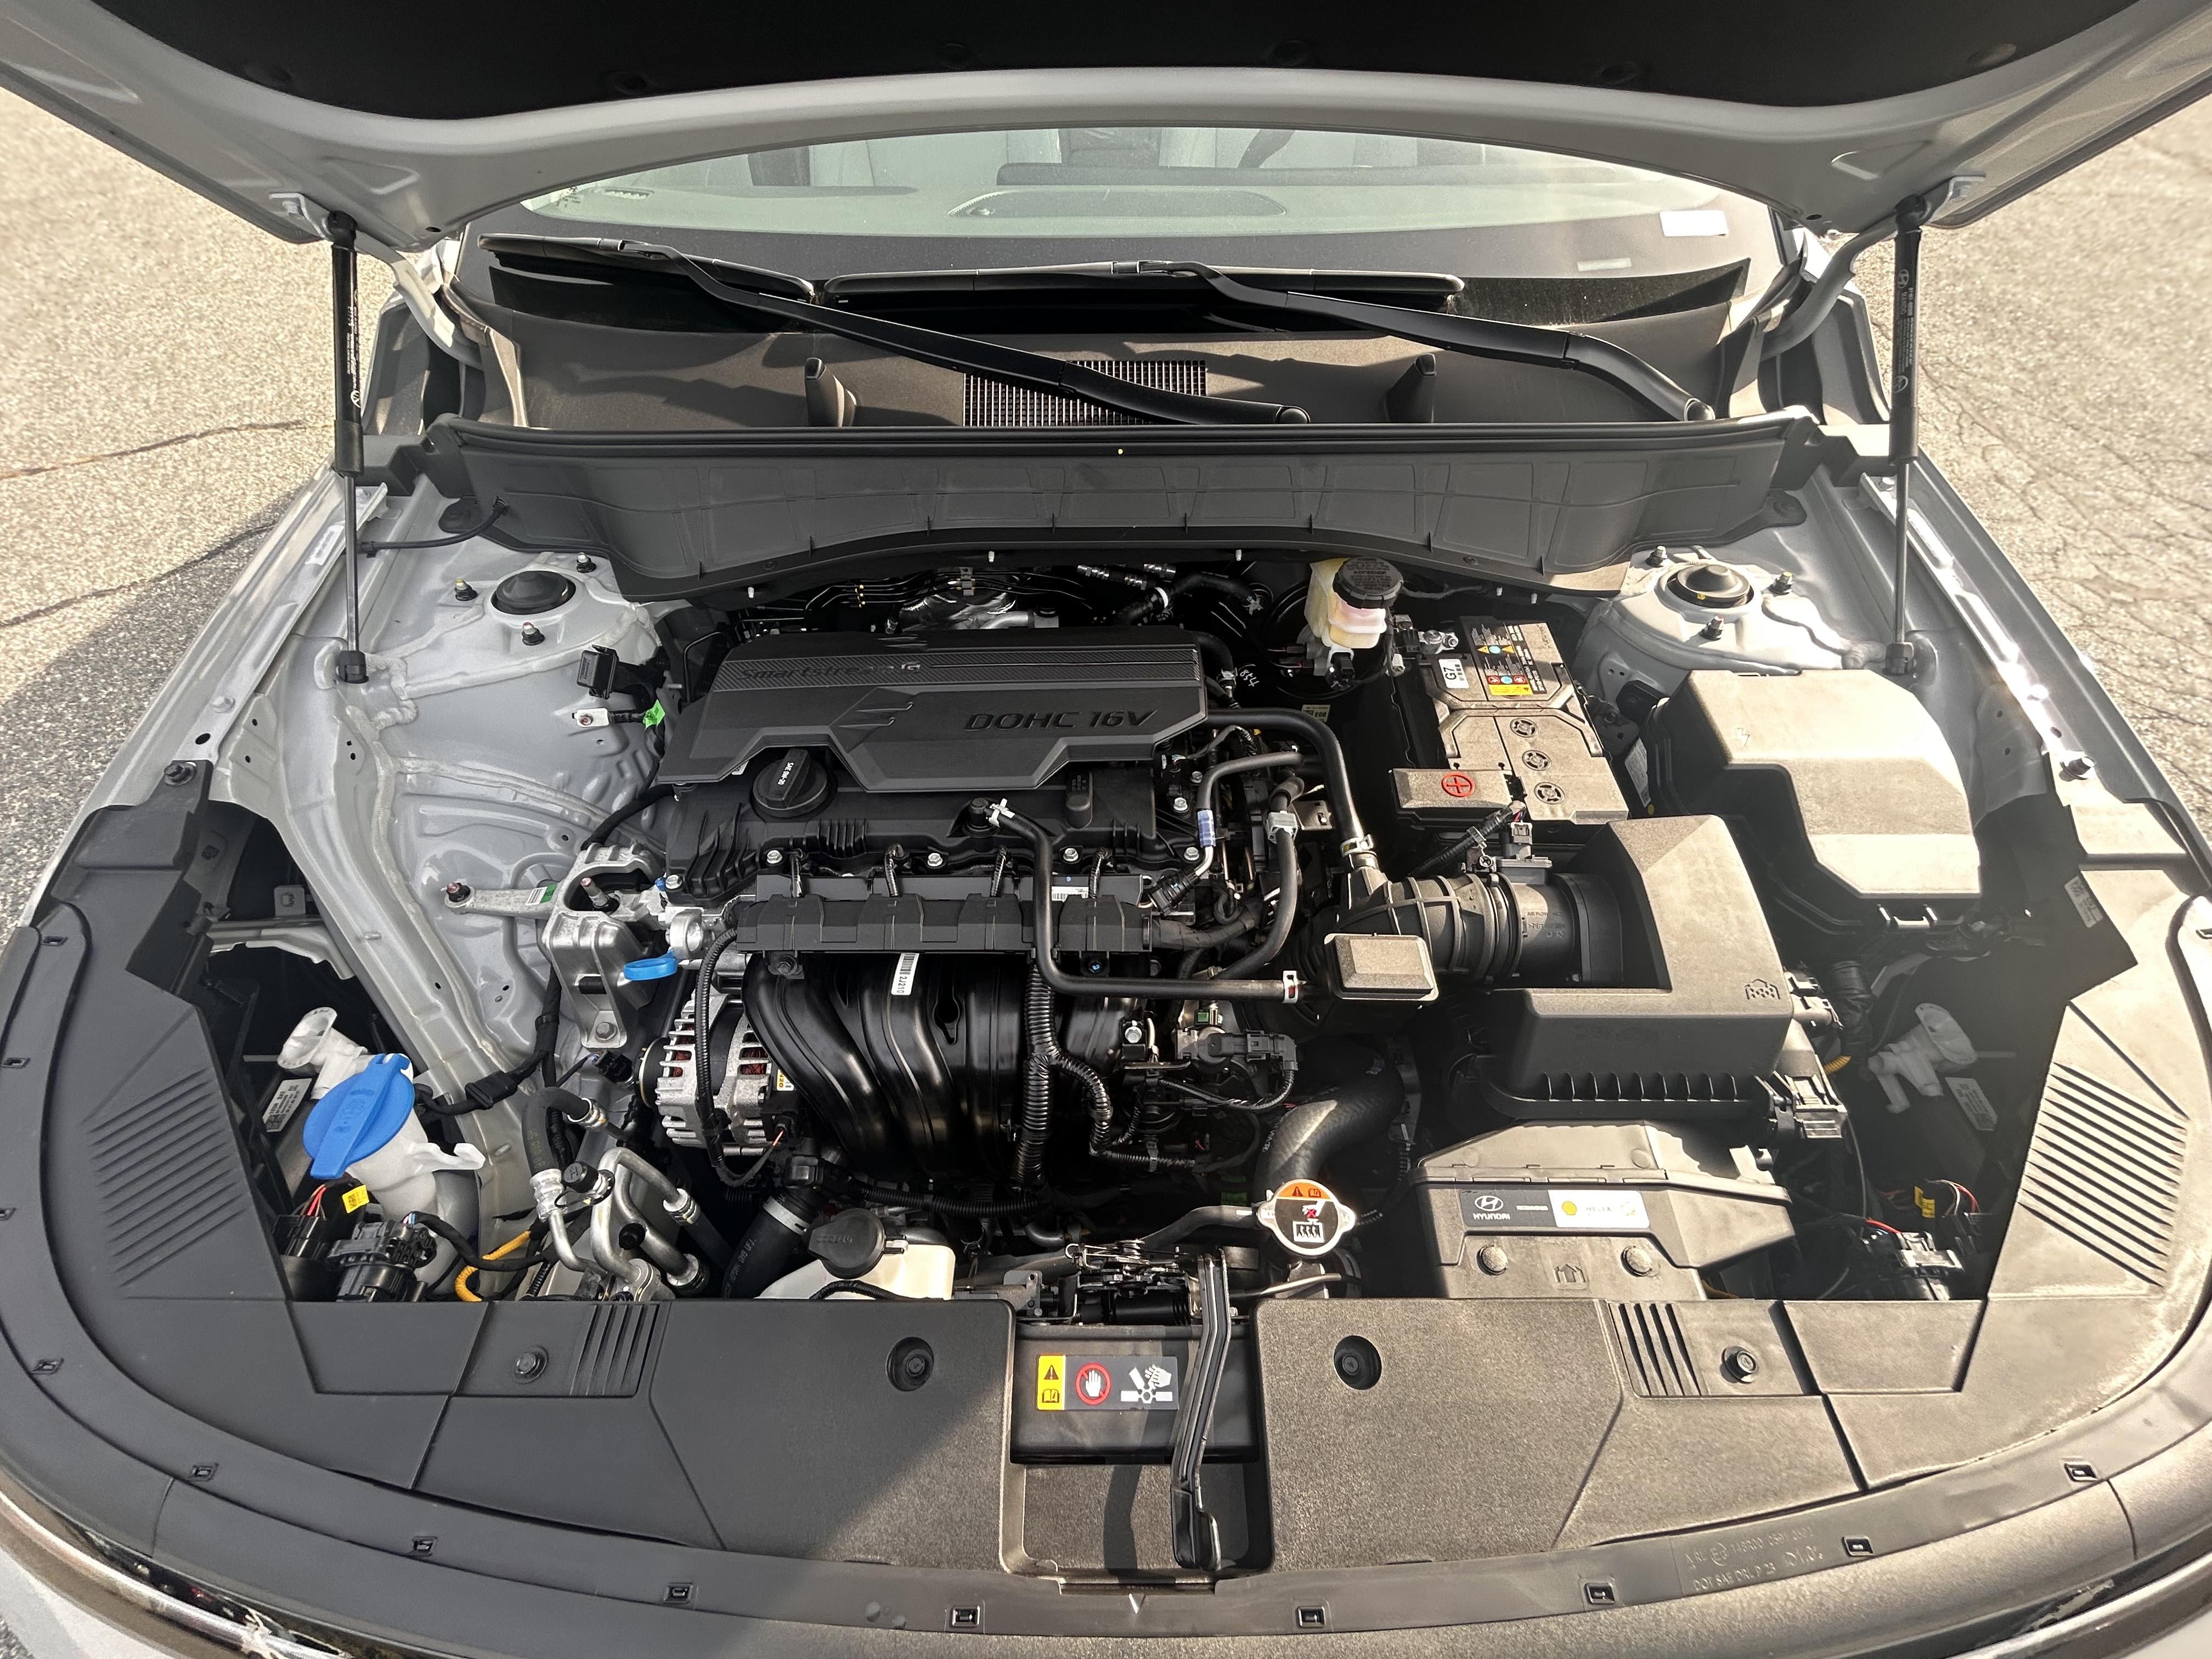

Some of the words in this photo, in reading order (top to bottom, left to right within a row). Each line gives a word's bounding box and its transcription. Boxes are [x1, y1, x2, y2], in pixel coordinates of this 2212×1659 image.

[1443, 667, 1457, 680] G7
[964, 712, 1081, 731] DOHC
[1090, 710, 1158, 729] 16V
[784, 761, 794, 771] SAE
[896, 976, 907, 994] 2J210
[1693, 1576, 1713, 1592] DOT
